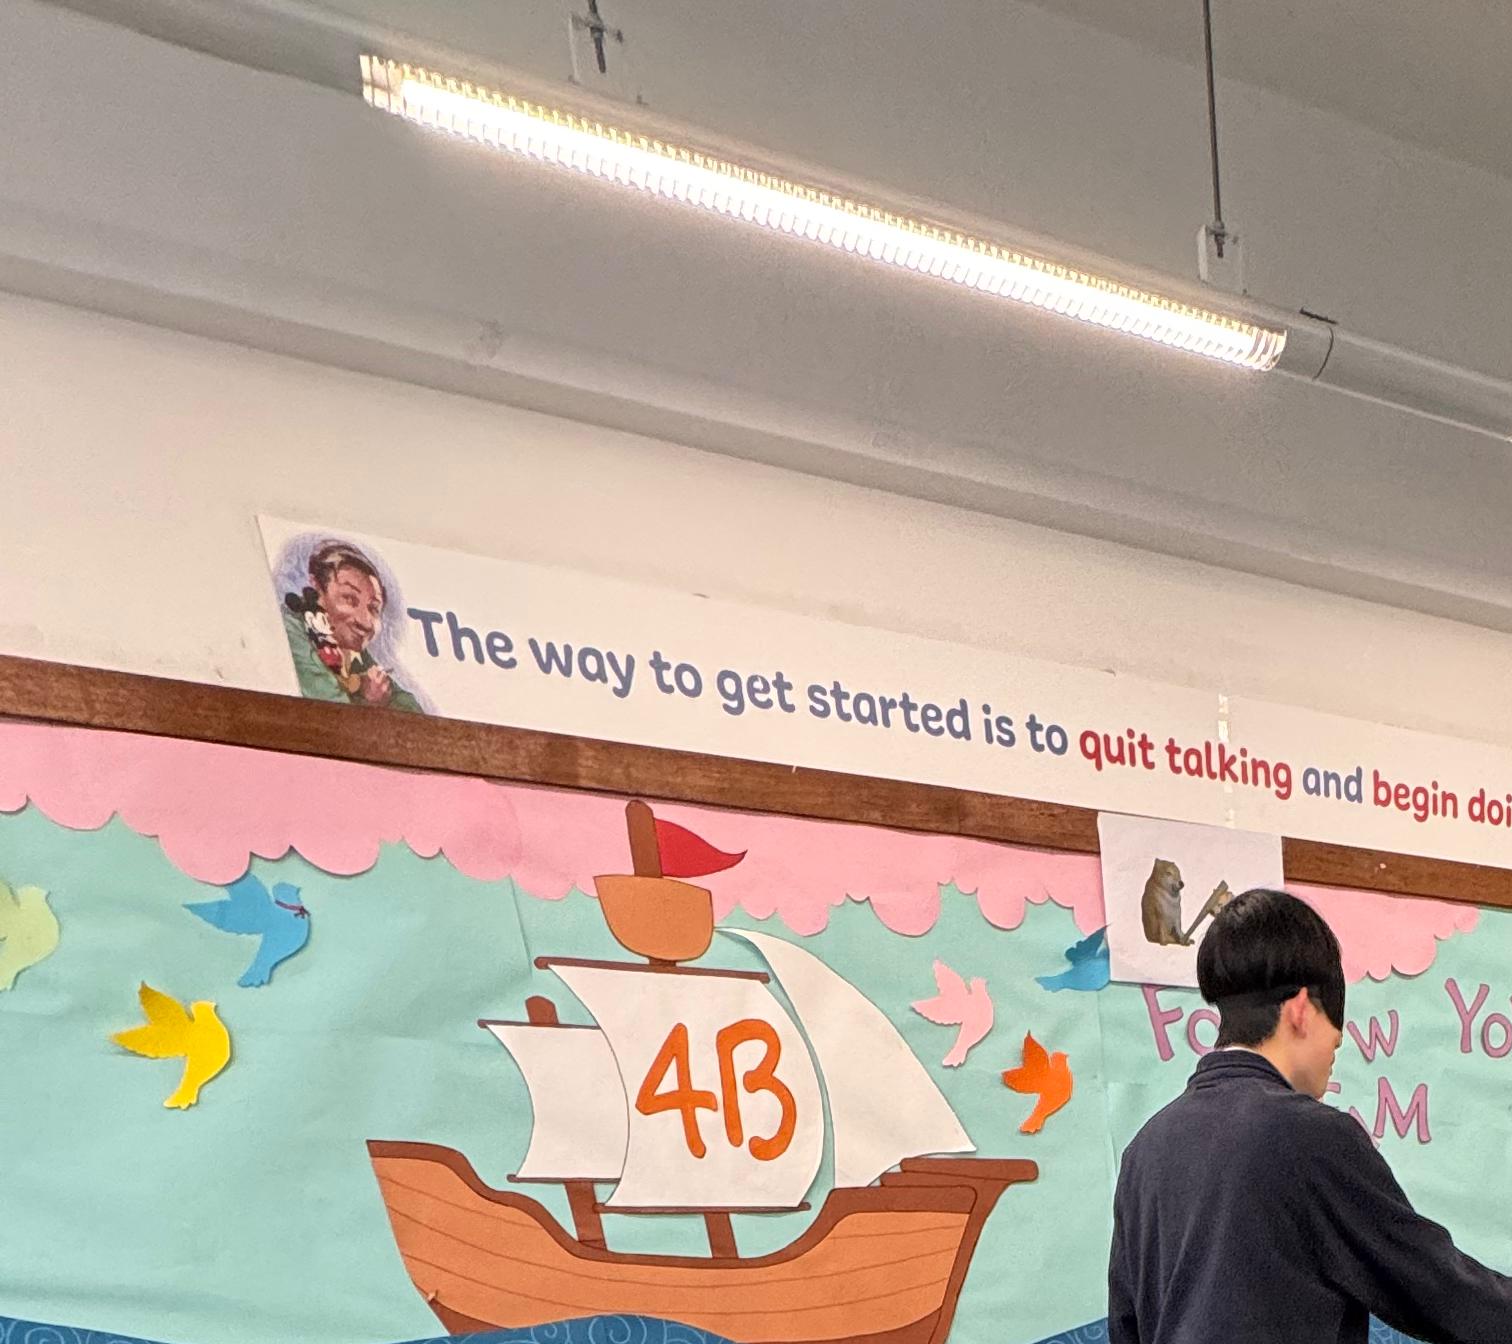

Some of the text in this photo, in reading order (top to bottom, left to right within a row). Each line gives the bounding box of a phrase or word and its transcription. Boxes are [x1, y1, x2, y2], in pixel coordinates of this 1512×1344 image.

[407, 607, 517, 670] The
[528, 637, 635, 698] way
[649, 650, 702, 699] to
[716, 669, 796, 716] get
[807, 680, 972, 741] started
[981, 703, 1017, 747] is
[1025, 713, 1069, 756] to
[1079, 728, 1156, 772] quit
[1165, 737, 1293, 800] talking
[1302, 766, 1363, 803] and
[1372, 769, 1458, 823] begin
[635, 1018, 798, 1161] 4B
